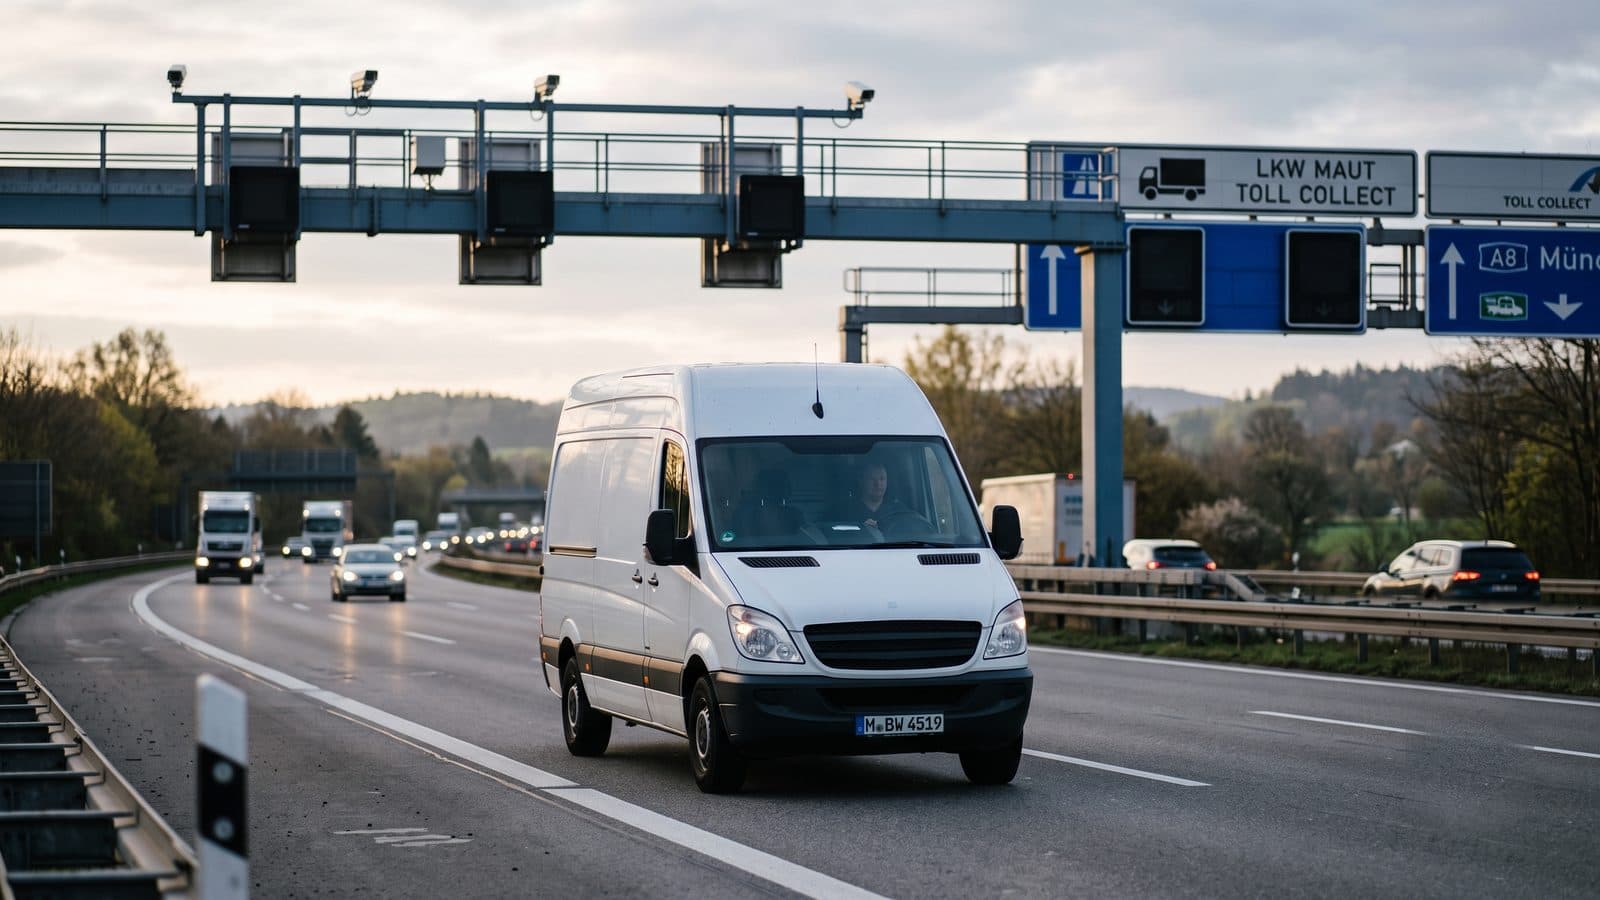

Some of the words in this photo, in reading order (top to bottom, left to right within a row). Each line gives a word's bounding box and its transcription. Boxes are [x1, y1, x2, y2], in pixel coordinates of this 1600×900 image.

[1257, 158, 1306, 179] LKW
[1314, 159, 1376, 180] MAUT
[1236, 183, 1291, 204] TOLL
[1299, 185, 1396, 206] COLLECT
[1503, 195, 1534, 209] TOLL
[1537, 196, 1592, 210] COLLECT
[1490, 247, 1517, 267] A8
[865, 717, 875, 733] M
[885, 716, 904, 732] BW
[907, 715, 942, 731] 4519
